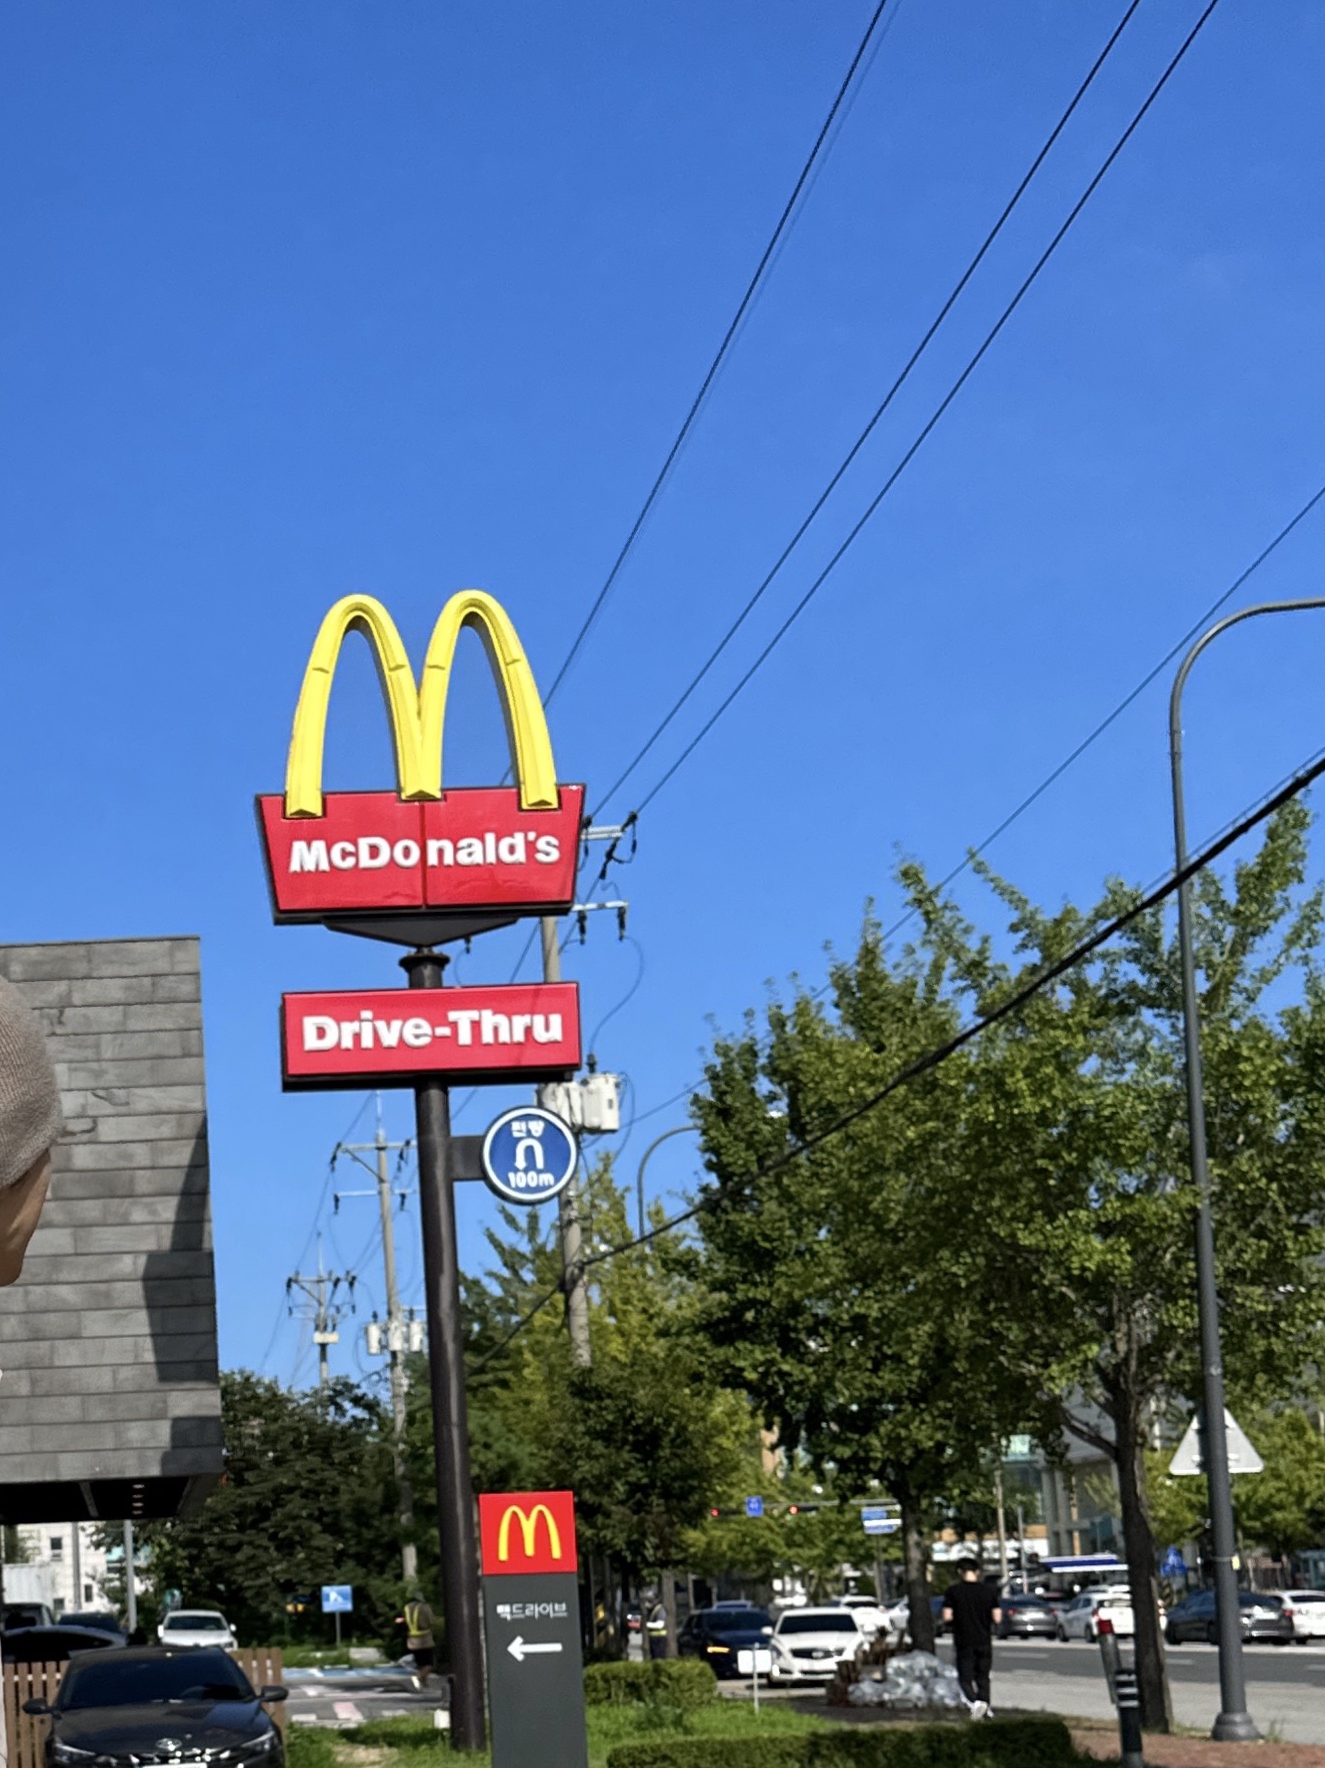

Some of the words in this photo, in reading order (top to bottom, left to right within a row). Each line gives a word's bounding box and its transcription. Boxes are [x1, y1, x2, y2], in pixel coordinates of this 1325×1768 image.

[288, 831, 561, 874] McDonald's
[301, 1009, 563, 1052] Drive-Thru
[507, 1170, 555, 1189] 100m
